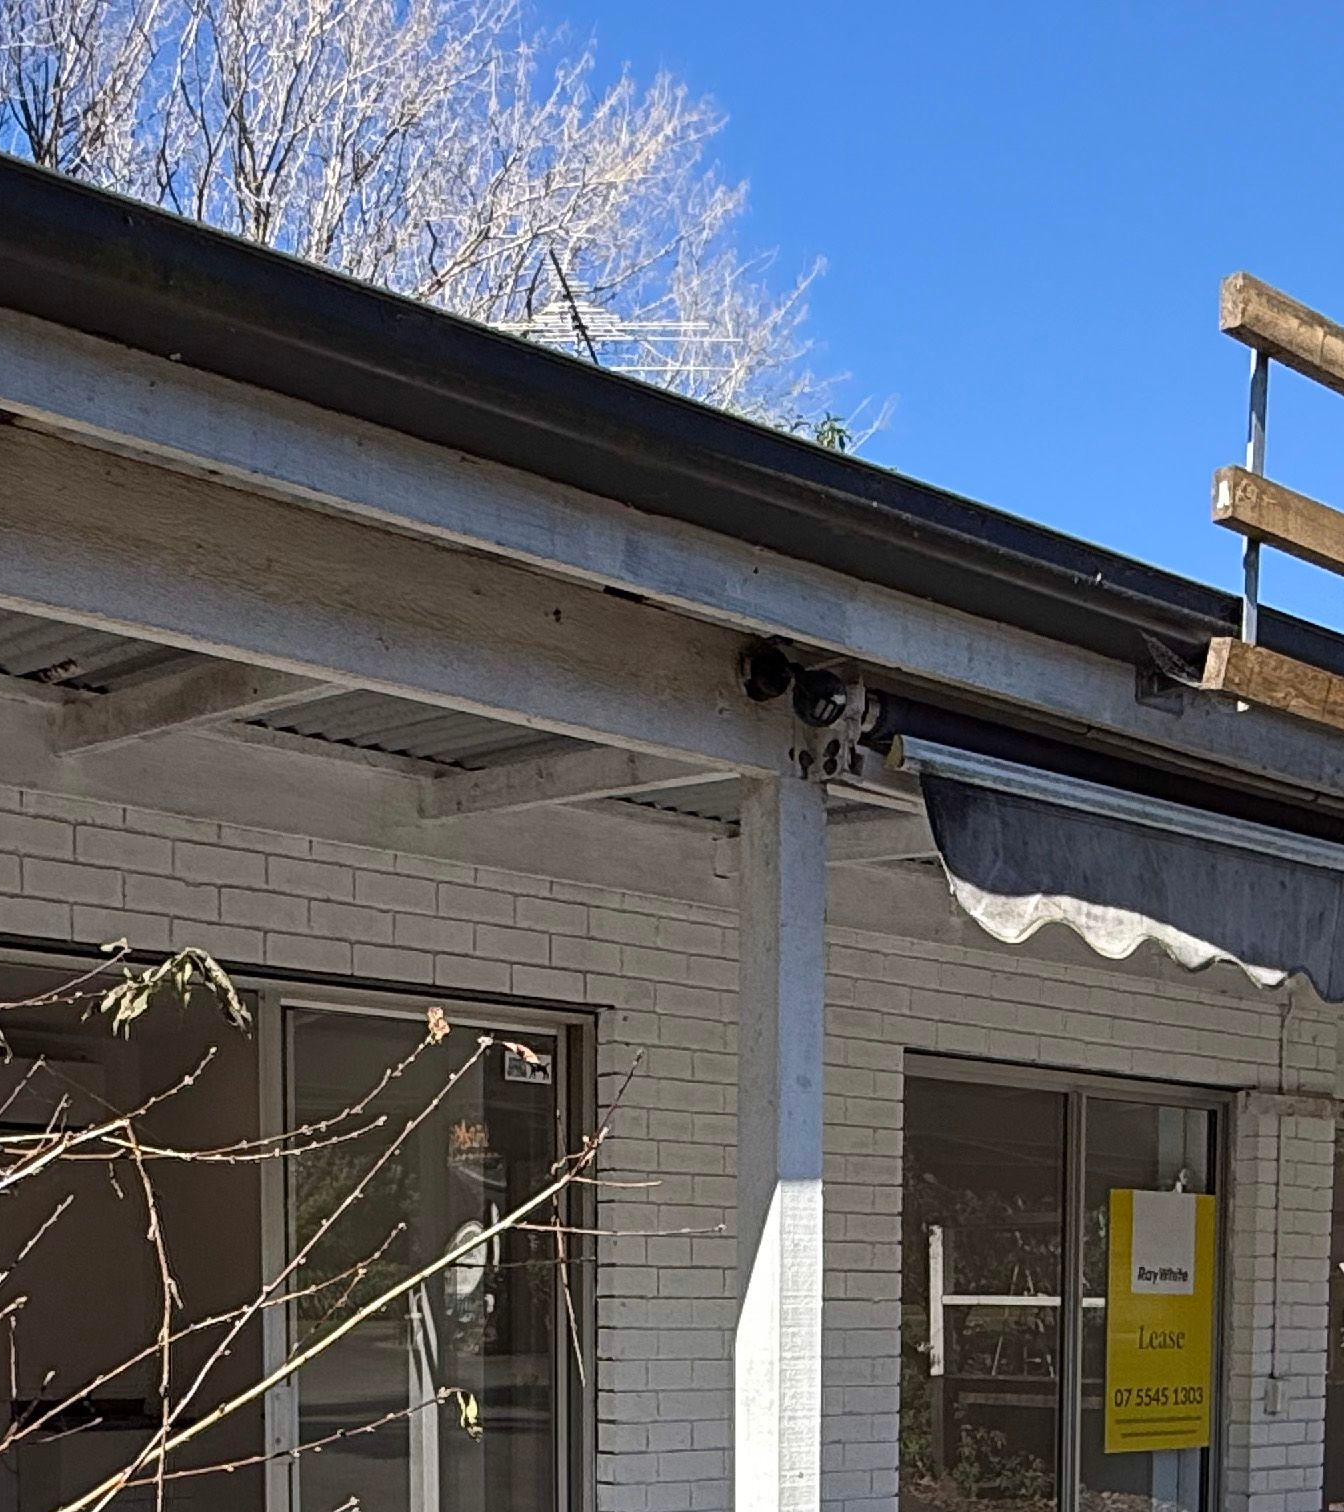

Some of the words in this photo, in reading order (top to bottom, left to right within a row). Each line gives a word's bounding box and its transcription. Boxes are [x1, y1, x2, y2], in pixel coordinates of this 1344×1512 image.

[1137, 1266, 1158, 1285] Ray
[1158, 1266, 1189, 1282] White
[1138, 1324, 1186, 1350] Lease
[1114, 1387, 1132, 1408] 07
[1135, 1386, 1169, 1407] 5545
[1172, 1386, 1204, 1406] 1303
